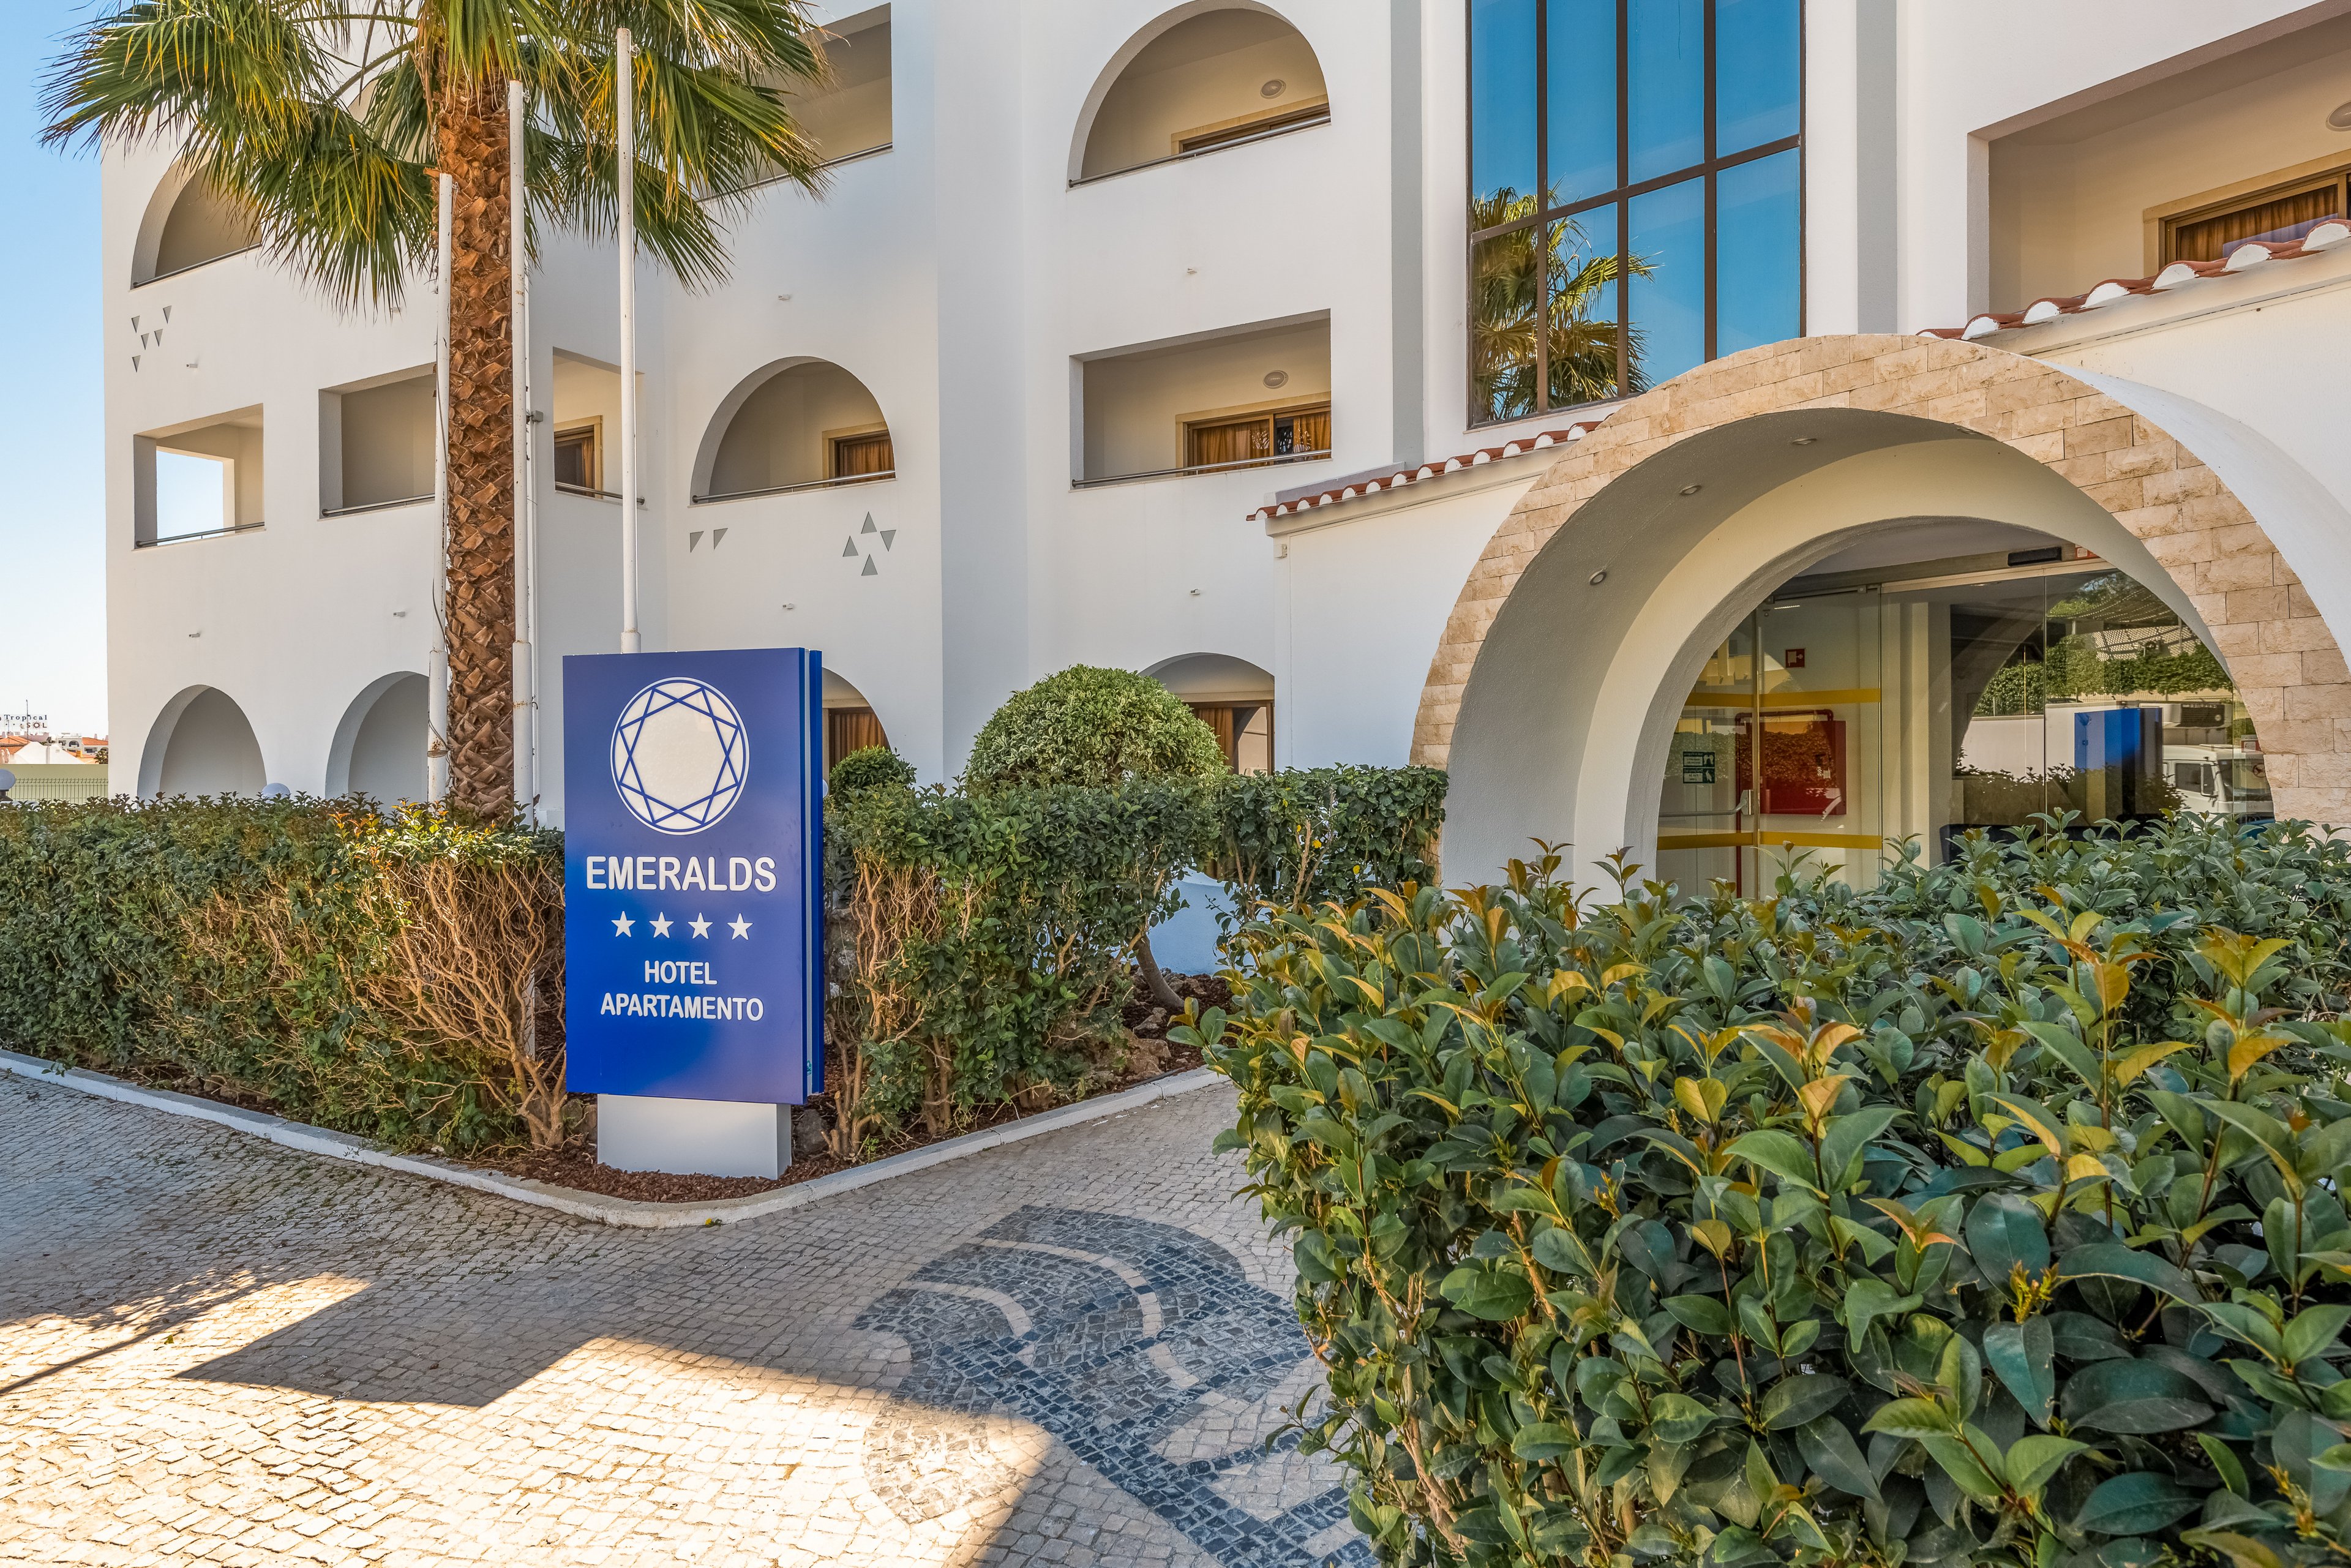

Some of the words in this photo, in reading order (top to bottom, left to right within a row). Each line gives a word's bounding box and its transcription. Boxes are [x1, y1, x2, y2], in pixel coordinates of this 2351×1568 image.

[587, 856, 777, 892] EMERALDS
[645, 960, 718, 985] HOTEL
[600, 992, 764, 1021] APARTAMENTO
